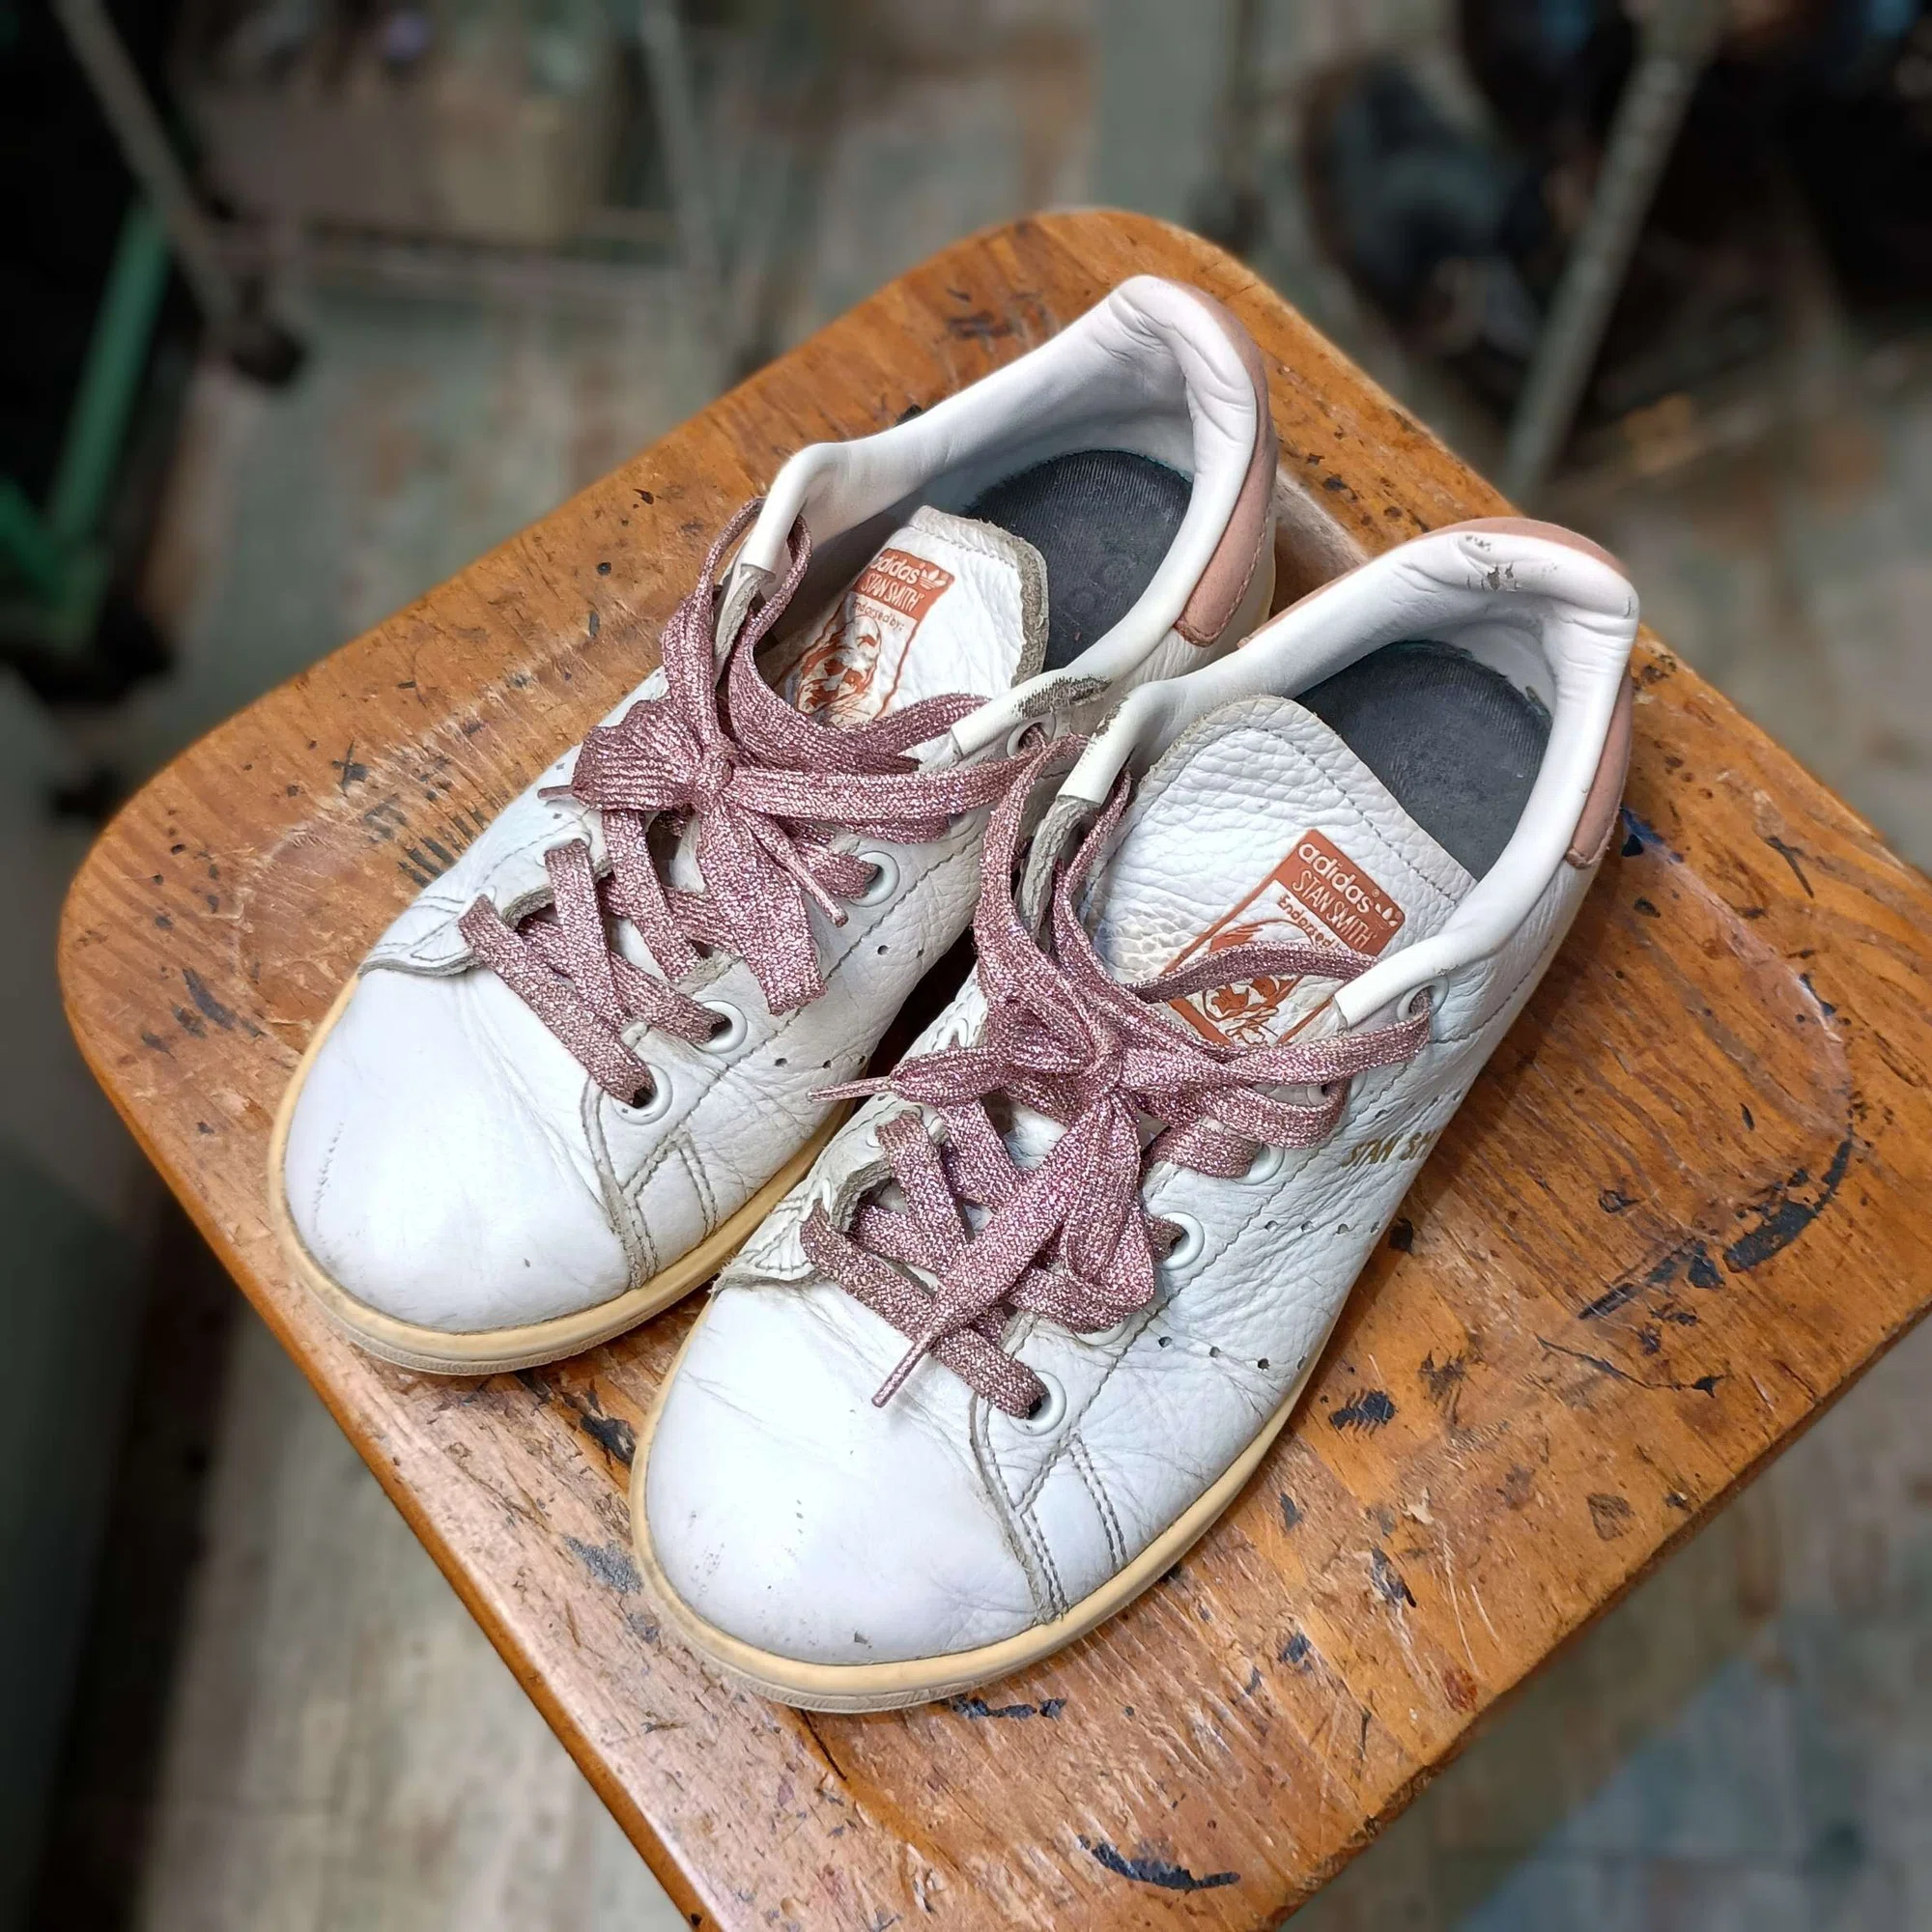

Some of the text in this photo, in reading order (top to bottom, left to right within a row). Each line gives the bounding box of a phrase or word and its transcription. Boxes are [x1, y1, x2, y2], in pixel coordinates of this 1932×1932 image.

[861, 573, 918, 611] STAN SMITH
[1293, 869, 1374, 950] STAN SMITH
[1298, 843, 1374, 913] adidas
